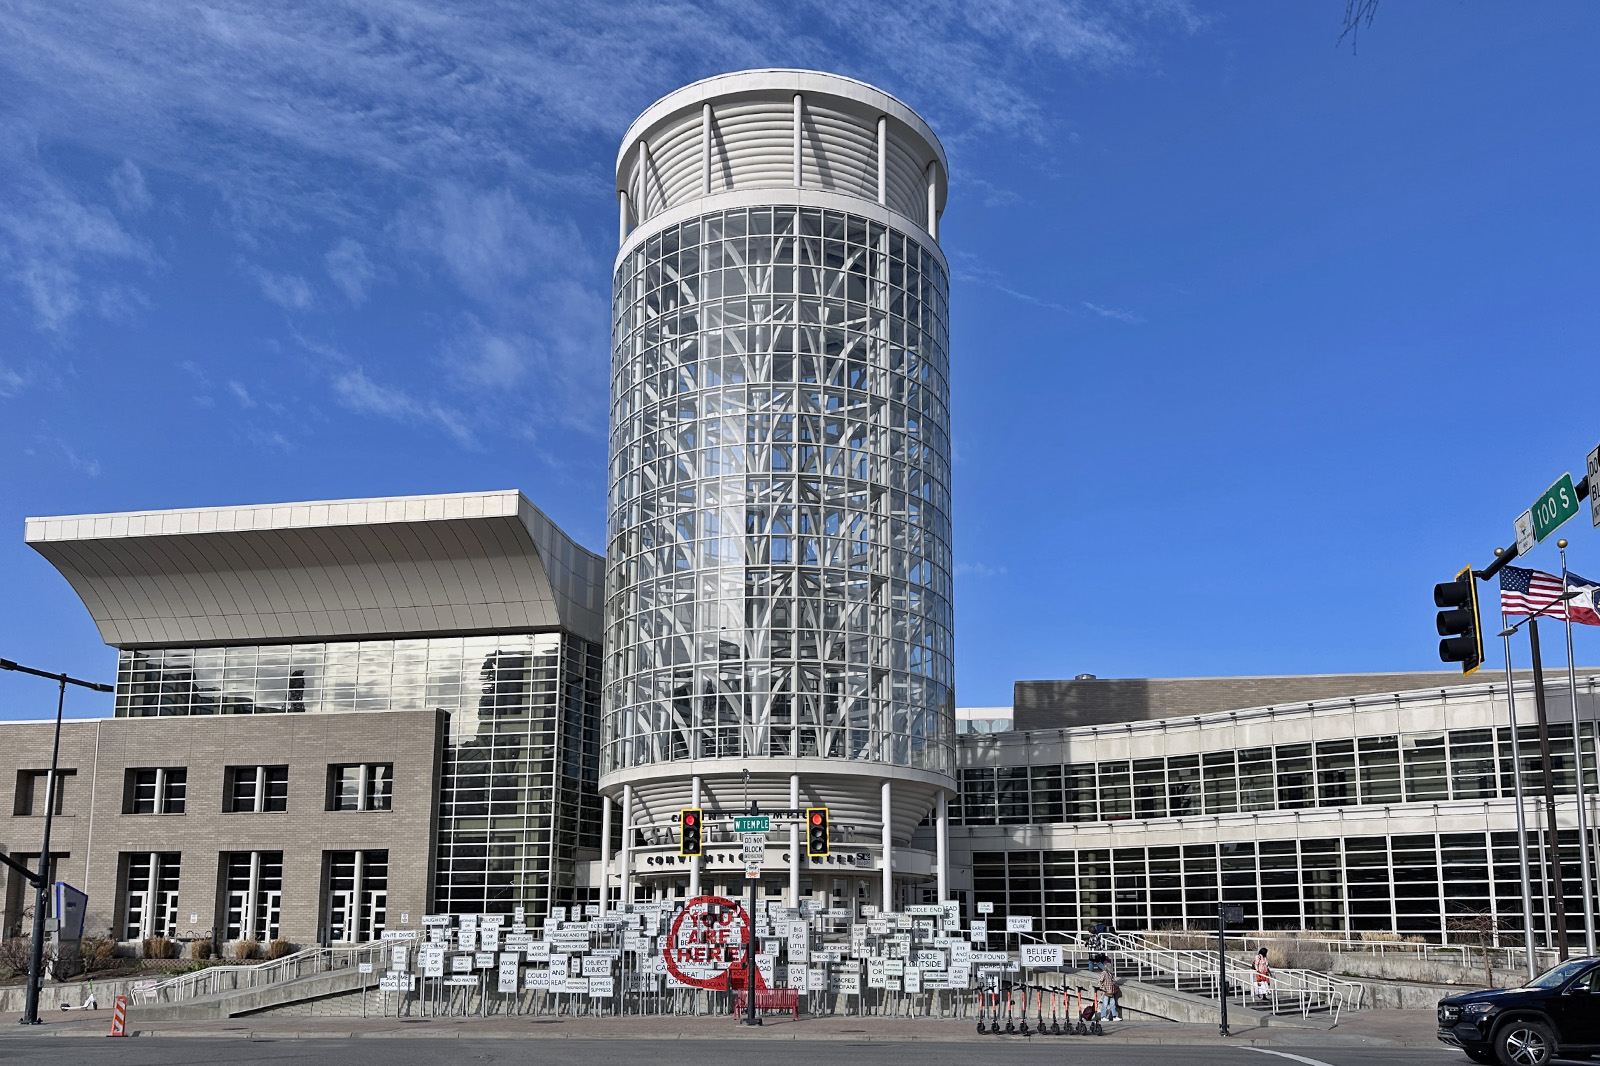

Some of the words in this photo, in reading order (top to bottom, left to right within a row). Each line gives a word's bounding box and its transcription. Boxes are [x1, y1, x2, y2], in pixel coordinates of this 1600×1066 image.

[1537, 497, 1557, 528] 100
[1560, 487, 1569, 508] S
[742, 820, 768, 829] TEMPLE
[691, 912, 733, 927] YOU
[689, 930, 731, 944] ARE
[678, 948, 740, 962] HERE
